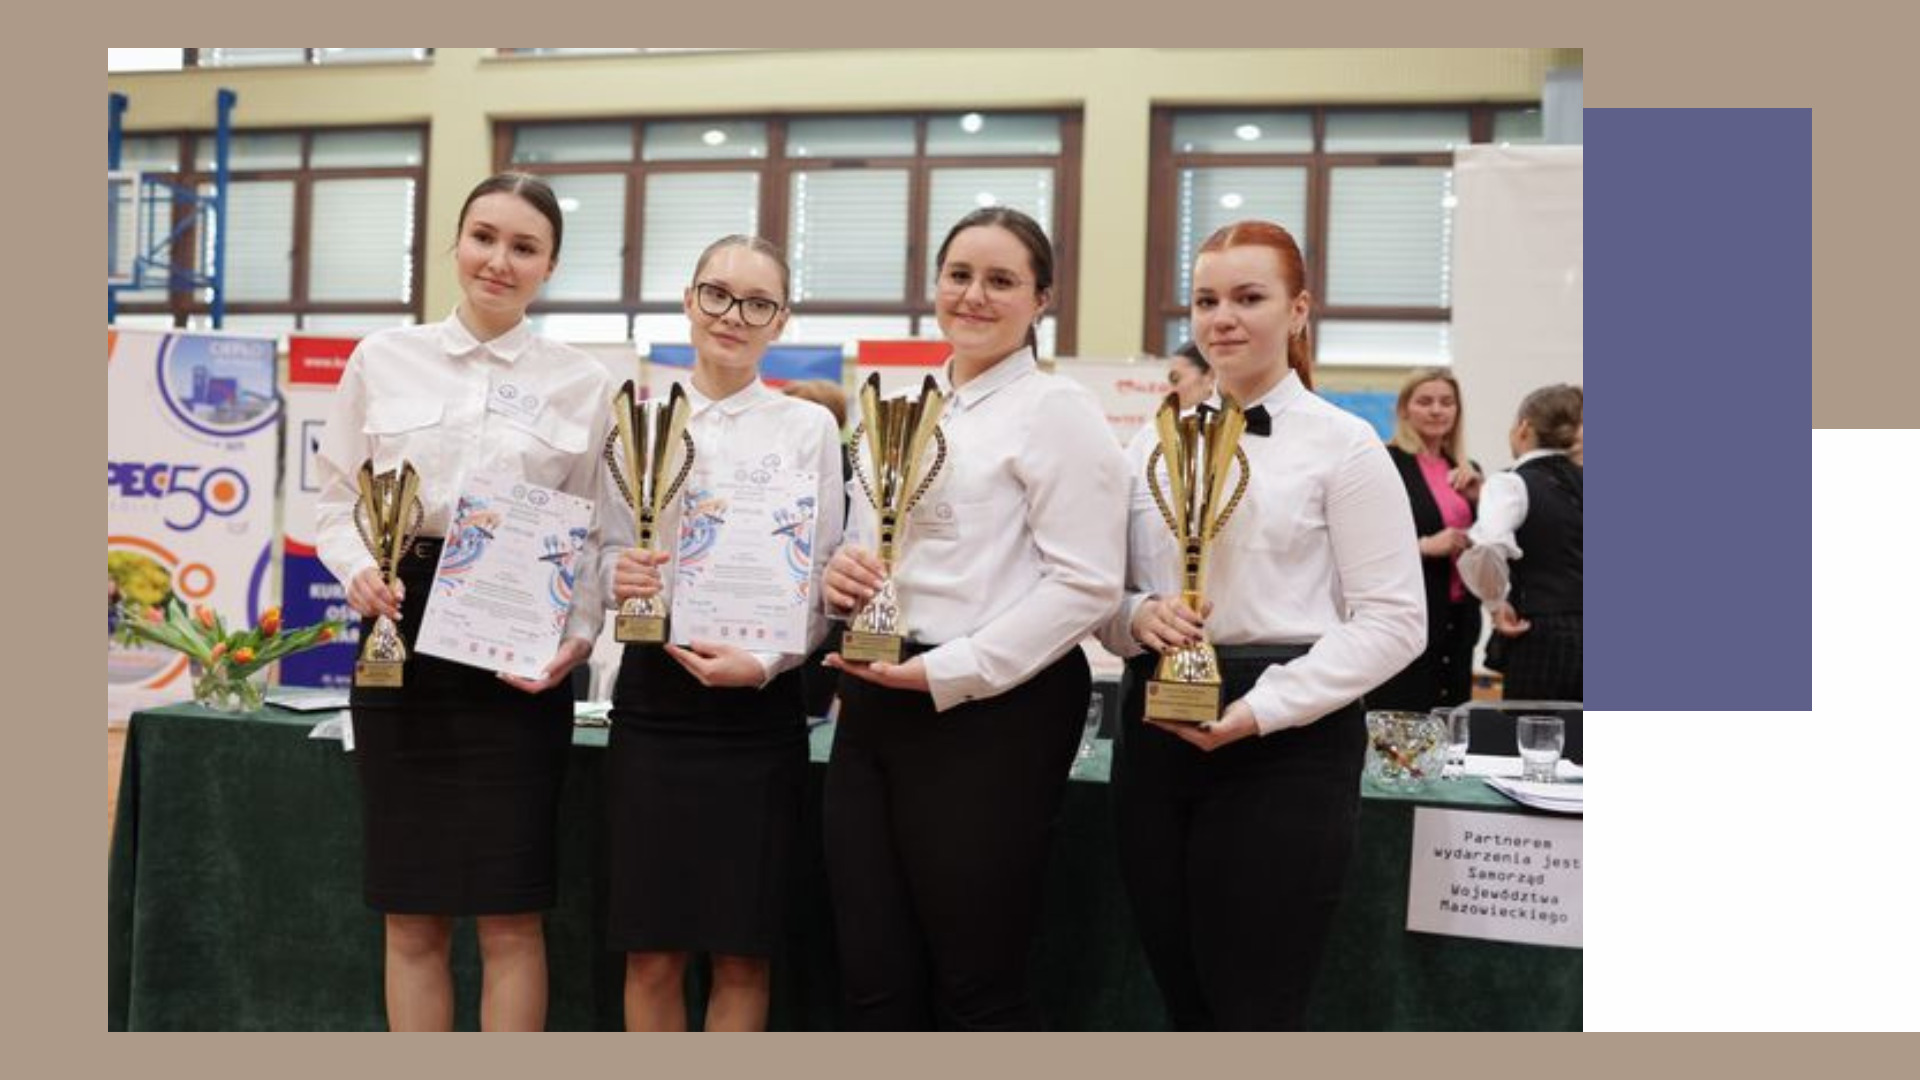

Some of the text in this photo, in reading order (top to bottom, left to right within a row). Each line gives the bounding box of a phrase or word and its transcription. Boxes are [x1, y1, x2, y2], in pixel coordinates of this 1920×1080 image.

[1464, 831, 1552, 849] Partnerem
[1434, 847, 1581, 870] wydarzenia jest
[1467, 867, 1545, 887] Samorząd
[1450, 883, 1559, 905] Województwa
[1439, 900, 1568, 925] Mazowieckiego
